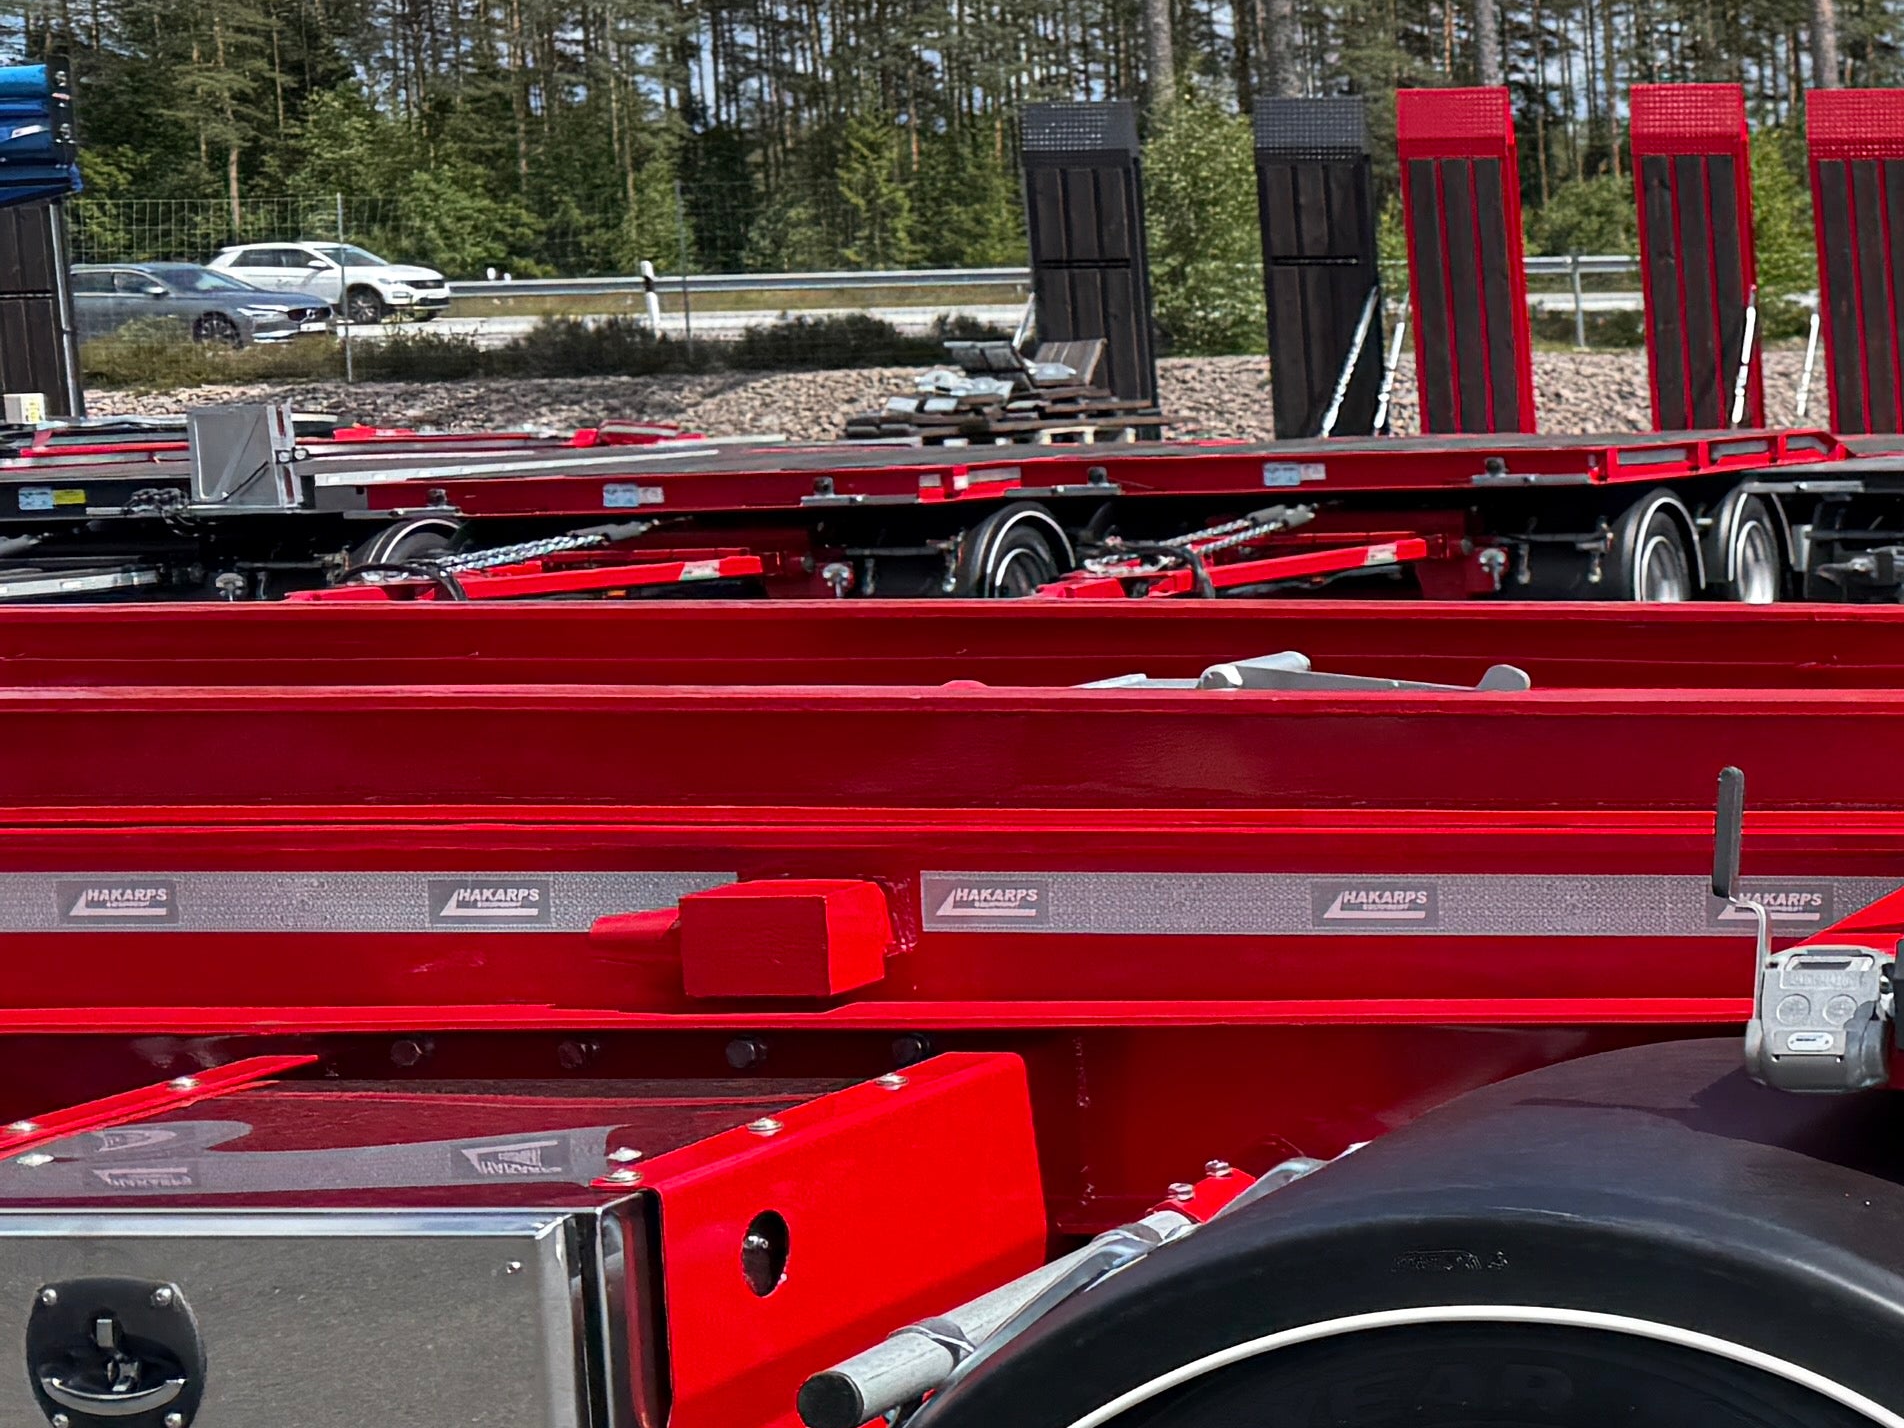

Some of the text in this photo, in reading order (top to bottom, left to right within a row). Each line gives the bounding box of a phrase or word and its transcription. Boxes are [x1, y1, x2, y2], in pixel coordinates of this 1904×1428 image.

[86, 888, 168, 902] HAKARPS
[458, 888, 540, 902] HAKARPS
[955, 888, 1039, 902] HAKARPS
[1343, 891, 1428, 905] HAKARPS
